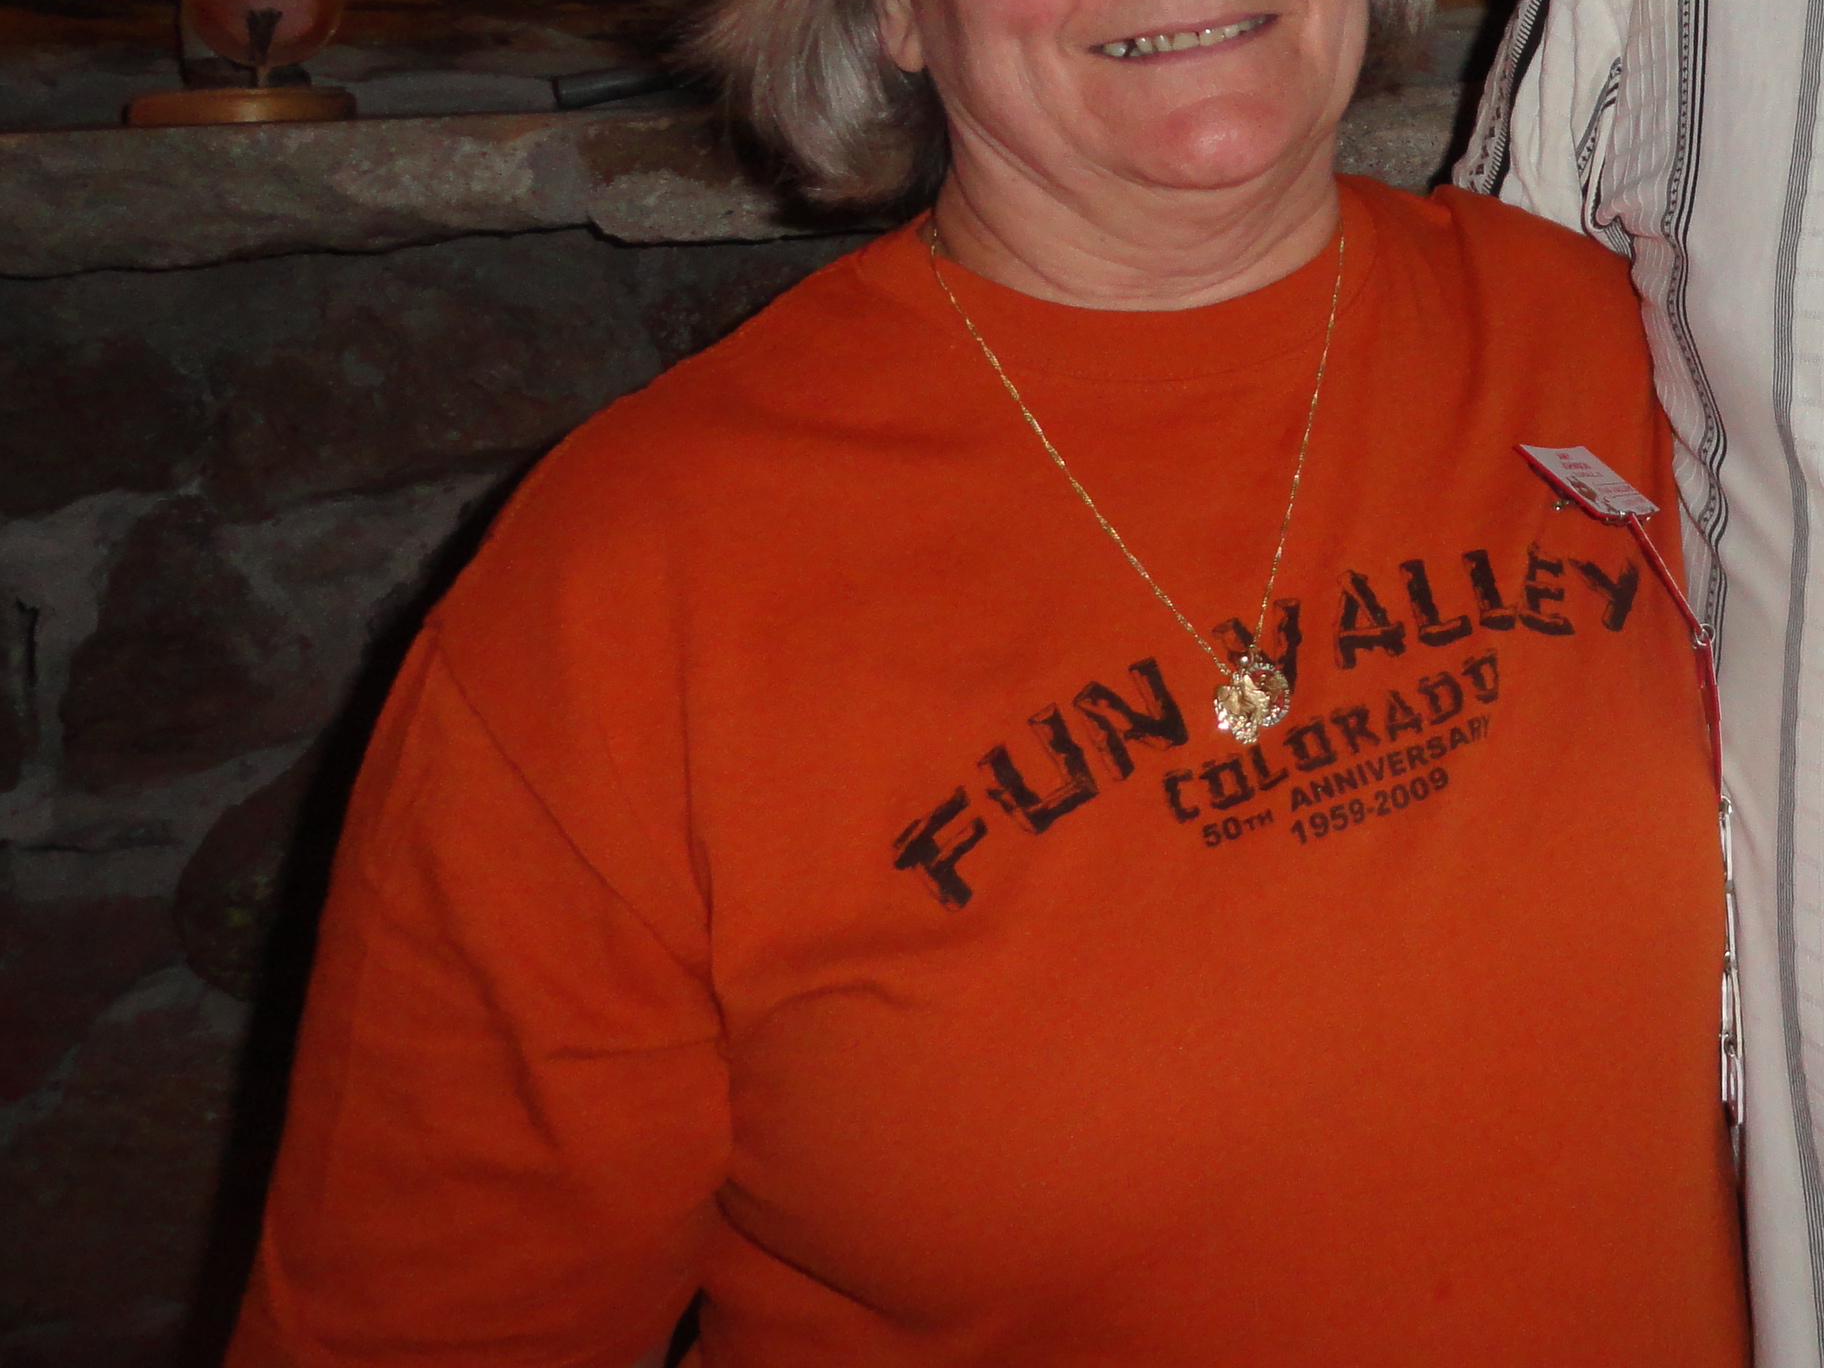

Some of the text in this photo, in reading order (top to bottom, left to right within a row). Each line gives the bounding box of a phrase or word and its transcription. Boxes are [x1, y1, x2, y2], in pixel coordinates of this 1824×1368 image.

[892, 543, 1643, 912] FUN VALLEY
[1162, 647, 1502, 824] COLORADO
[1201, 713, 1492, 851] 50TH ANNIVERSARY
[1289, 767, 1450, 846] 1959-2009
